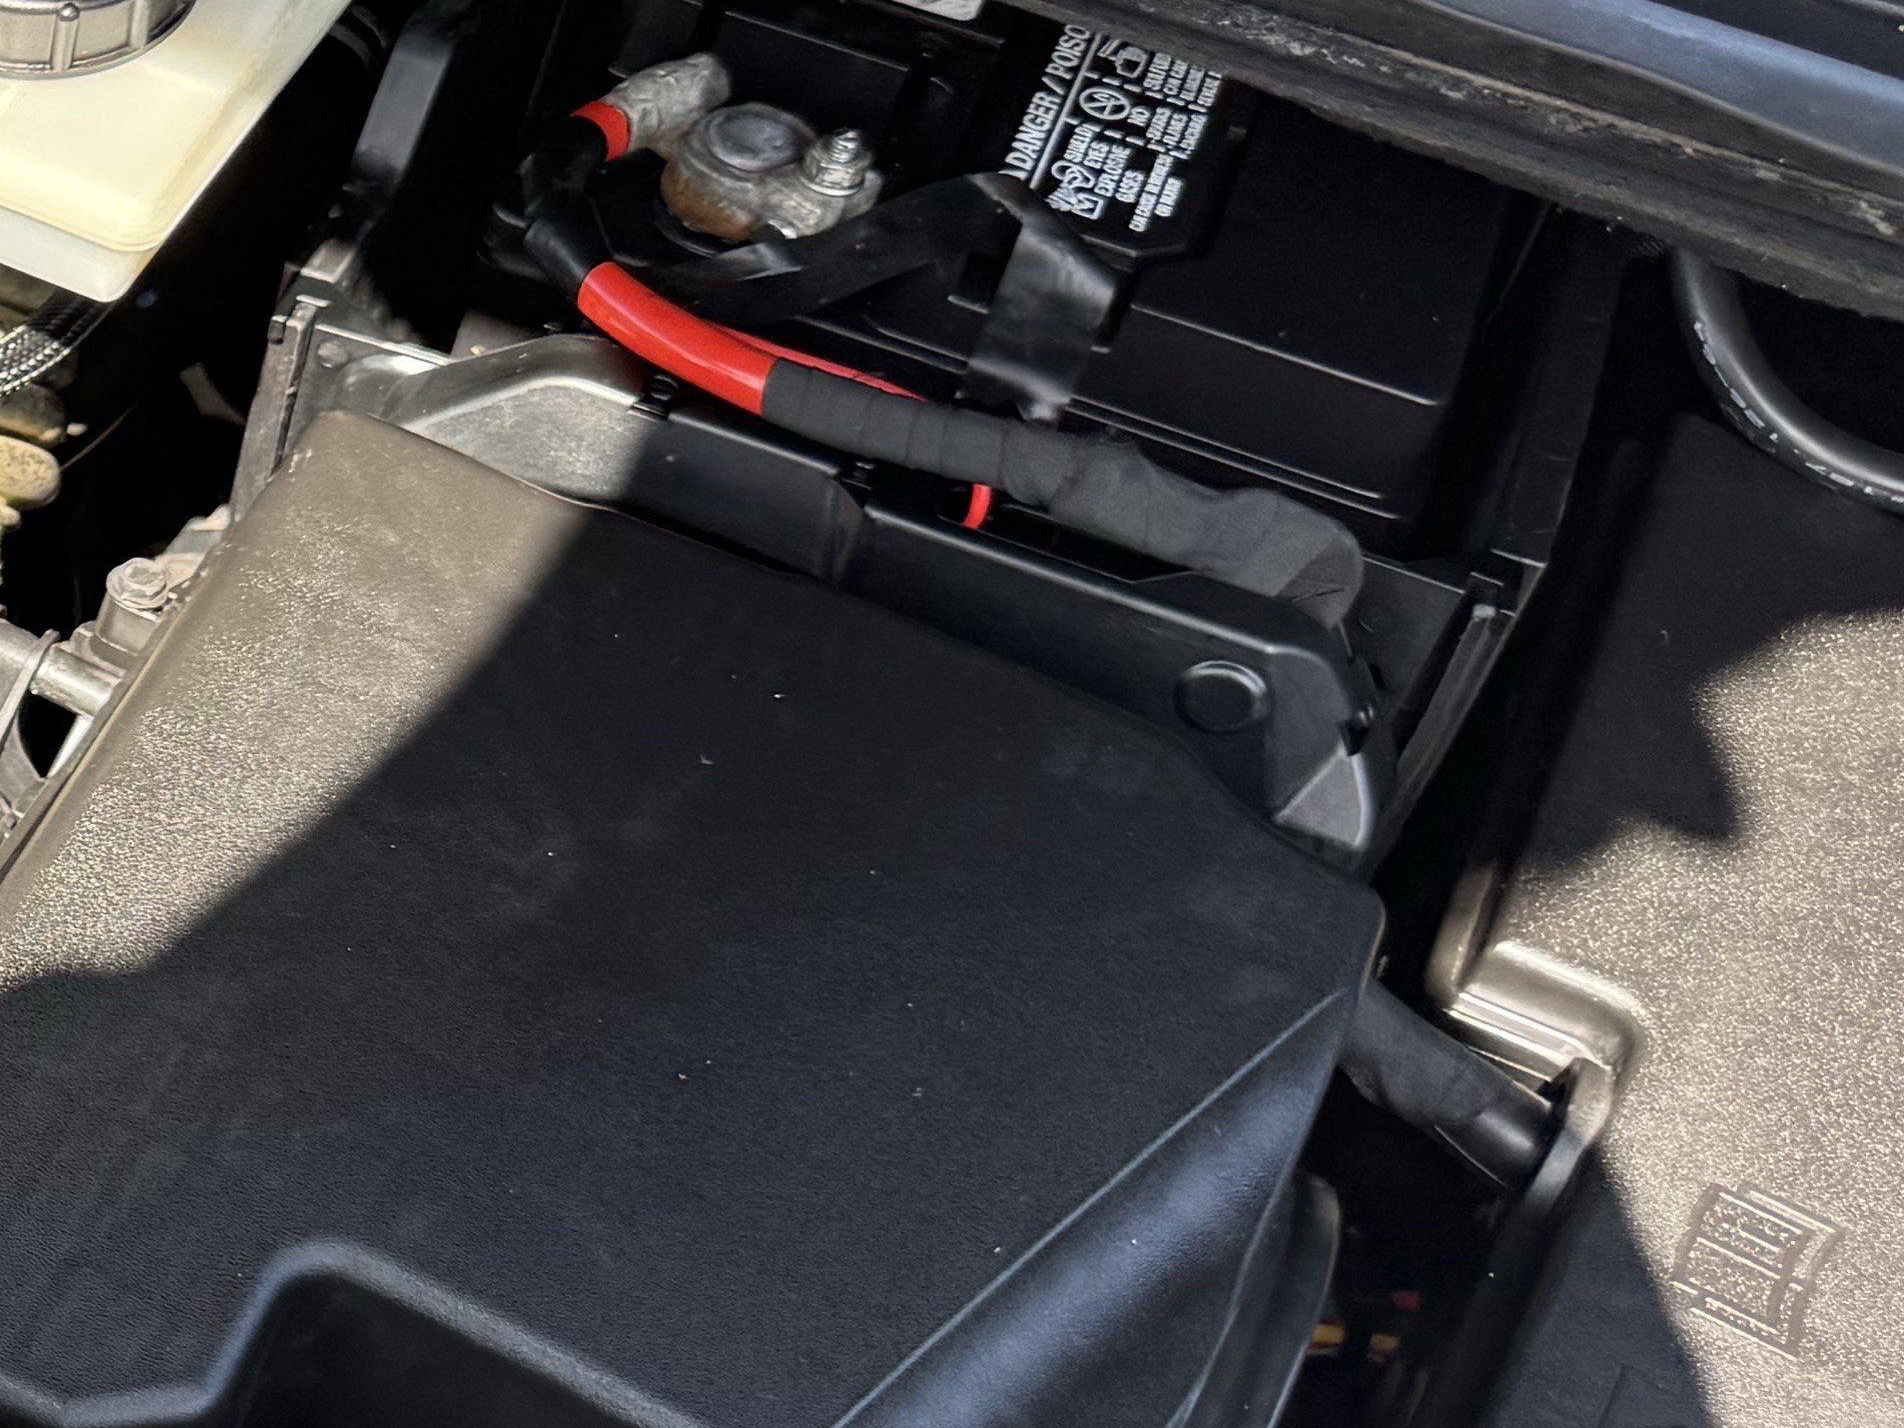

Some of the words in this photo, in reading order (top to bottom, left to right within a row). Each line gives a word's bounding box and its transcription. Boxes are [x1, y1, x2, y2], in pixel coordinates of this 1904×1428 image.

[1004, 91, 1061, 170] DANGER
[1045, 23, 1090, 79] POISO
[1126, 105, 1150, 126] NO
[1082, 140, 1110, 169] EYES
